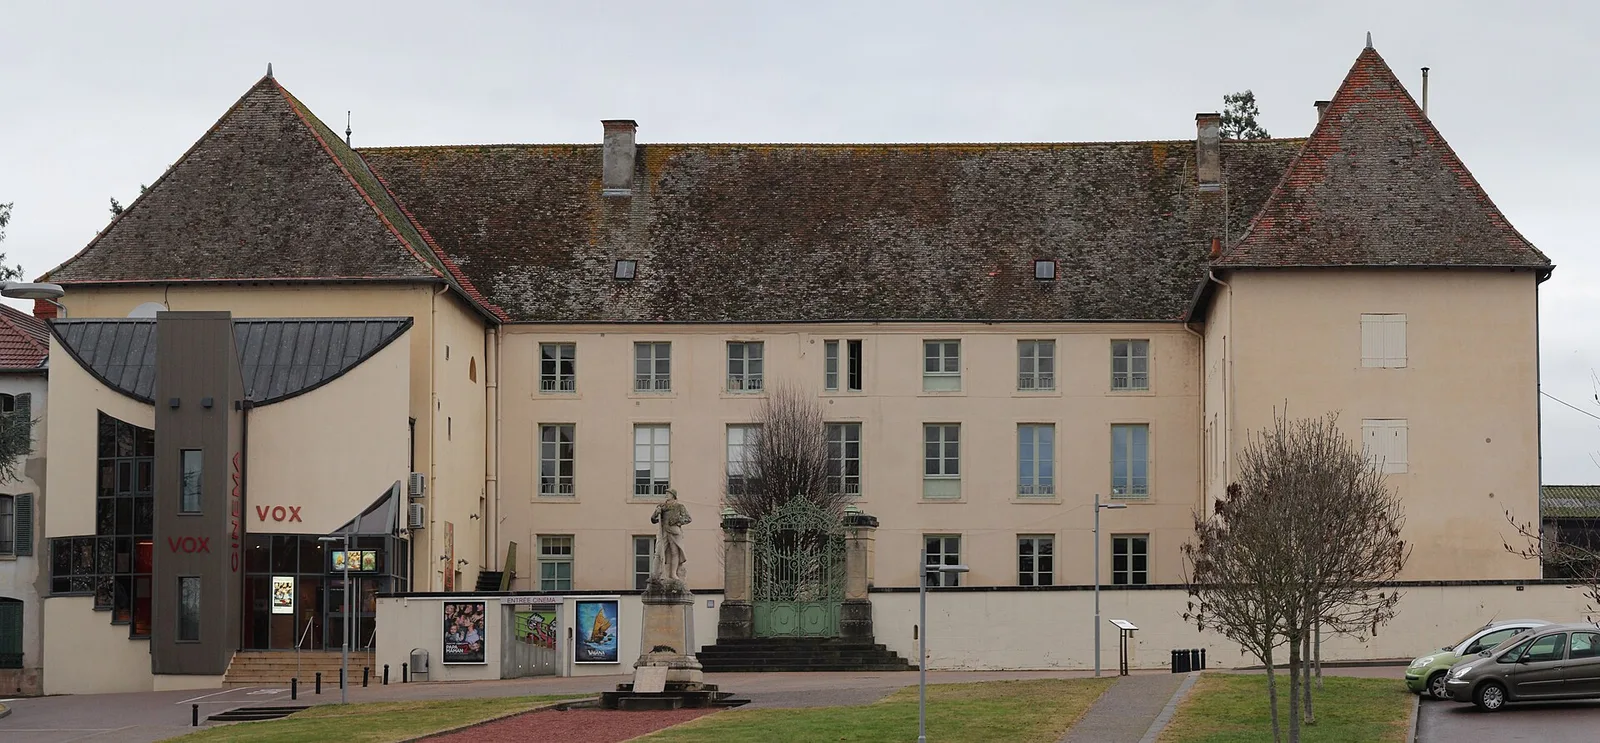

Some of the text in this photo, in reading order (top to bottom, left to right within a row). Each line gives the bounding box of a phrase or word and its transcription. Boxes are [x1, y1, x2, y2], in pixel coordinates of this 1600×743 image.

[231, 451, 241, 573] CINEMA
[255, 505, 303, 523] VOX
[167, 536, 211, 554] VOX
